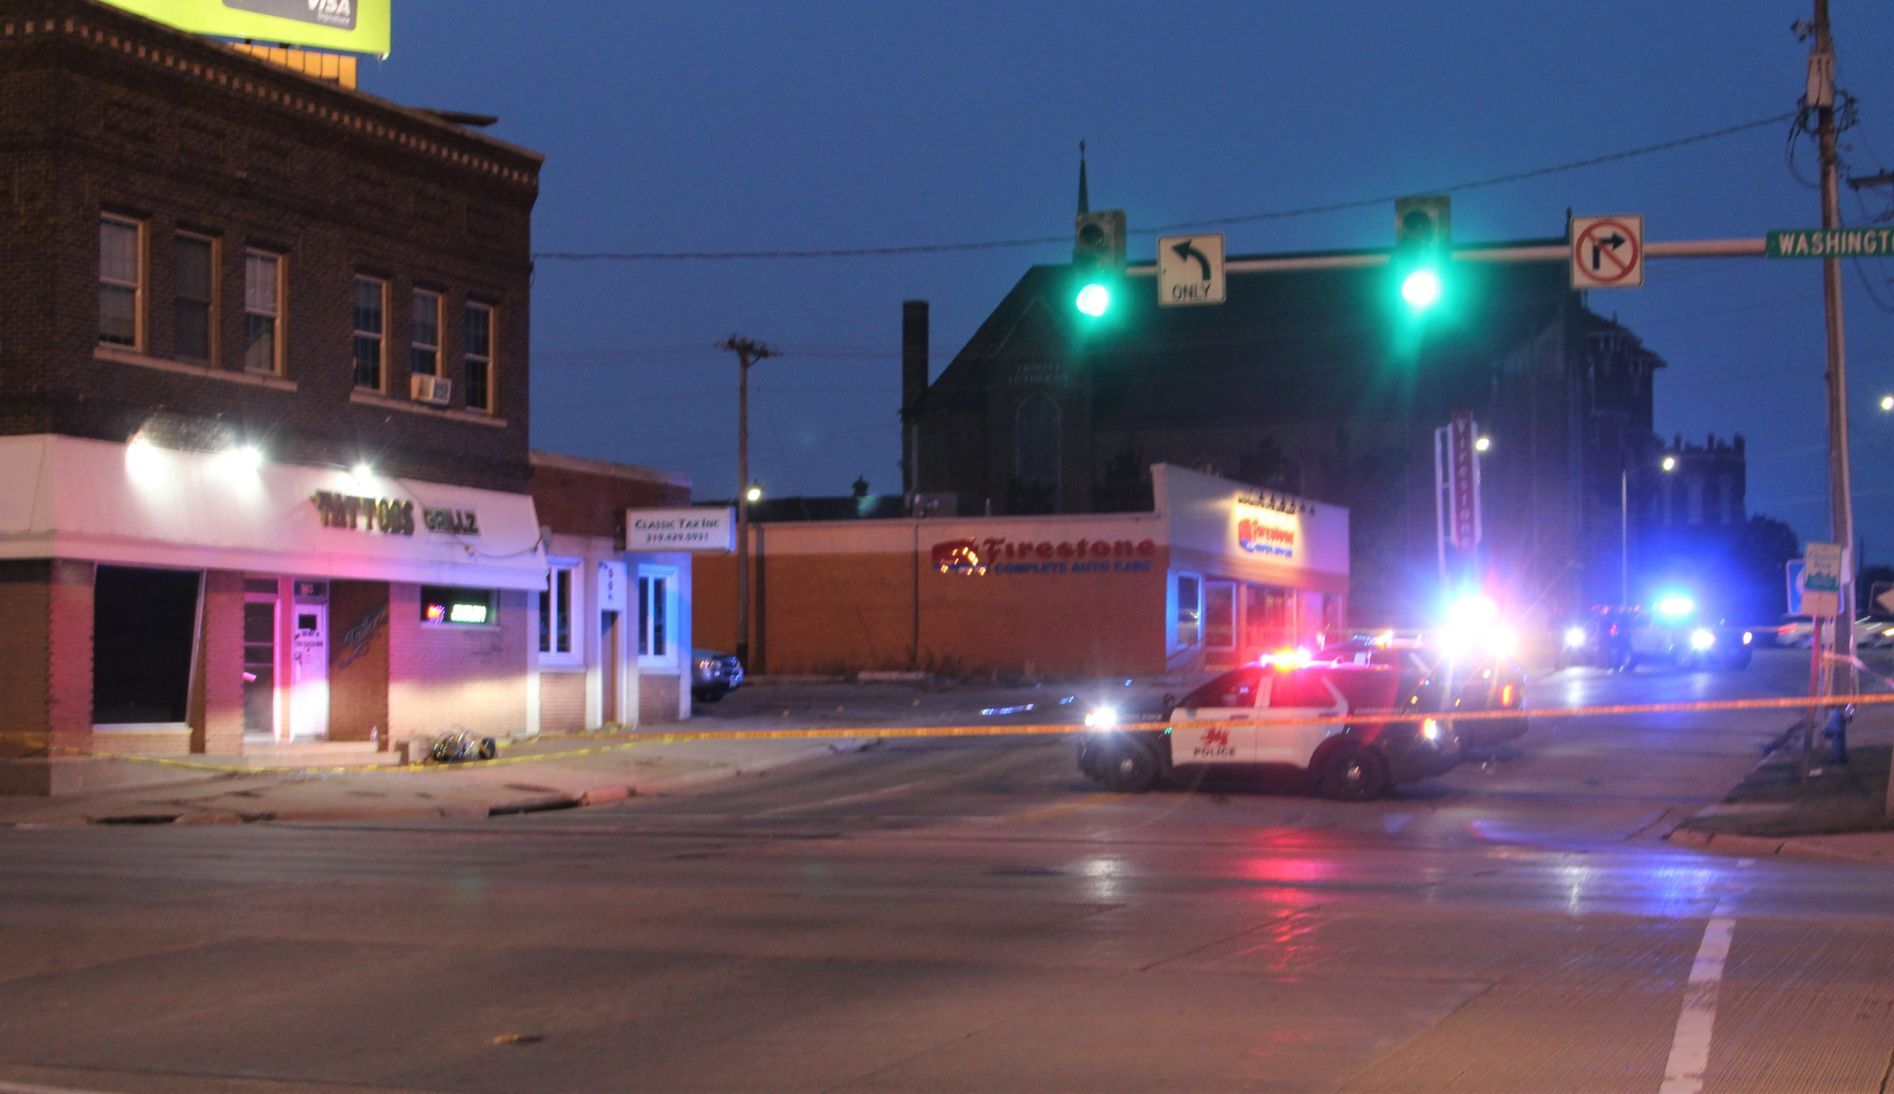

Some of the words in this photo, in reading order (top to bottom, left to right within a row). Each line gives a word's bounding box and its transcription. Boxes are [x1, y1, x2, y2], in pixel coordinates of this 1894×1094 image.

[1778, 229, 1894, 256] WASHINGT
[1172, 283, 1212, 299] ONLY
[983, 537, 1155, 564] Firestone
[995, 562, 1067, 573] COMPLETE
[1072, 561, 1110, 573] AUTO
[1193, 746, 1236, 757] POLICE
